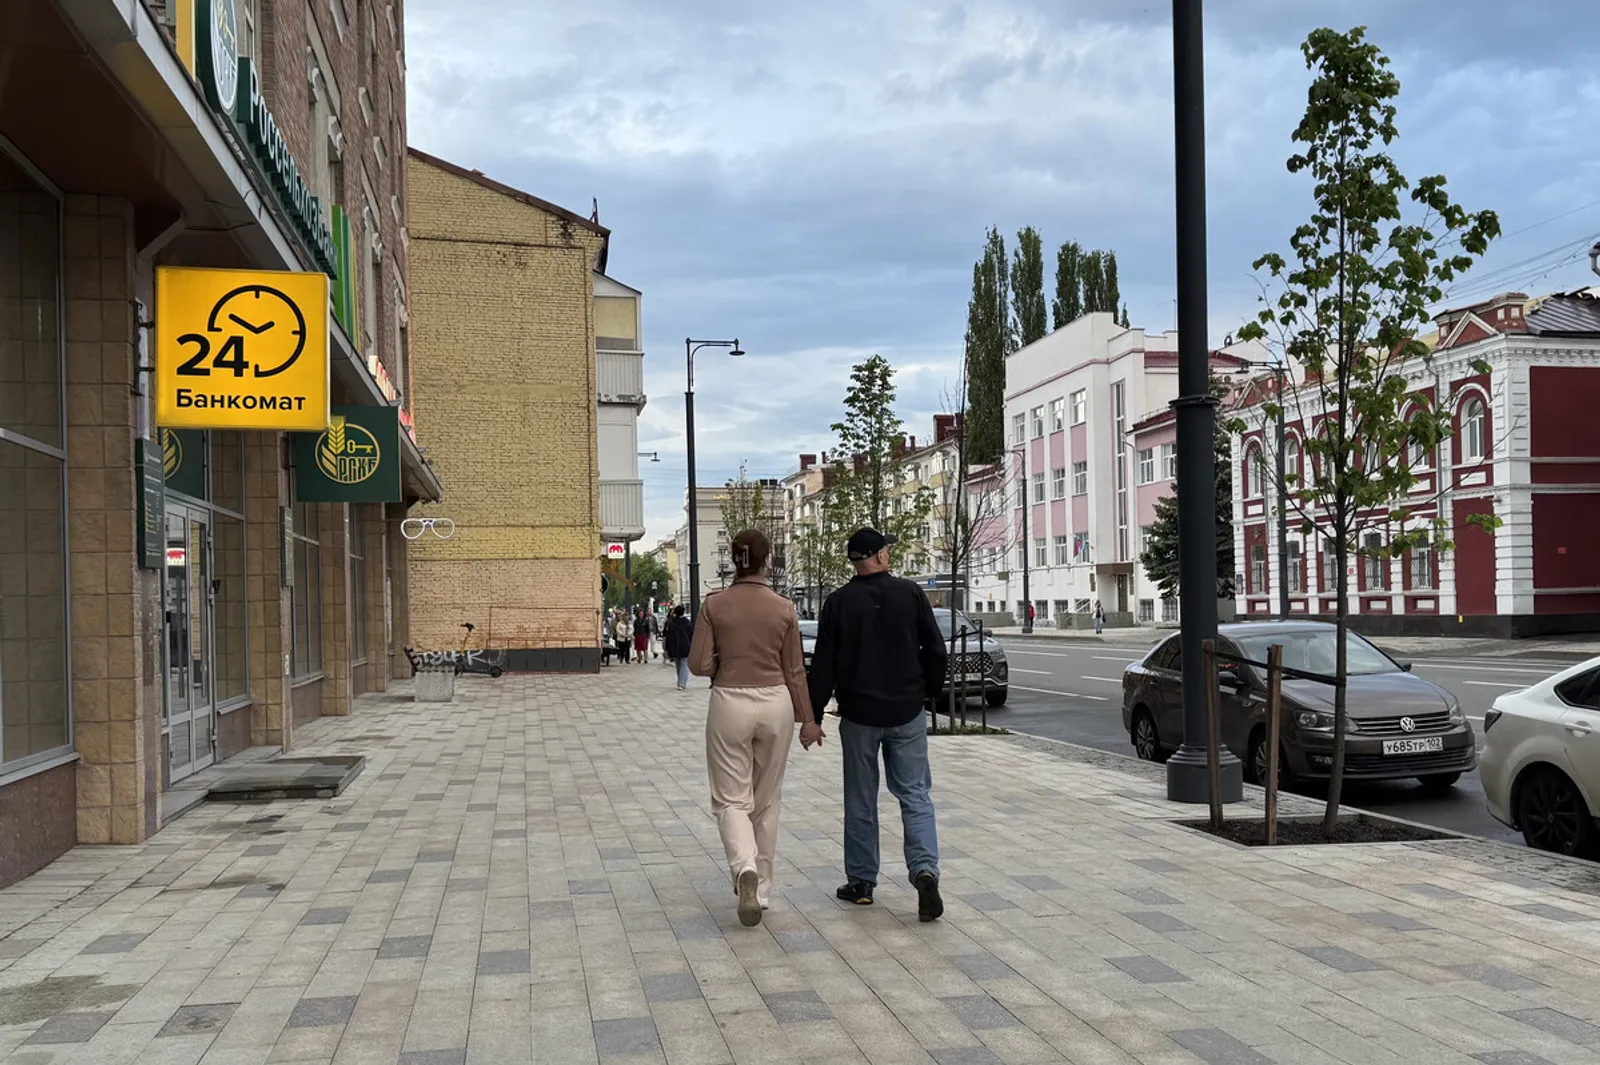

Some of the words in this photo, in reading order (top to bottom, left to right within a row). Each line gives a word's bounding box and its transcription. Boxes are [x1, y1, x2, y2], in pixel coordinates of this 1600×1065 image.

[250, 60, 338, 274] Россельхозба
[176, 334, 249, 377] 24
[176, 388, 306, 411] Банкомат
